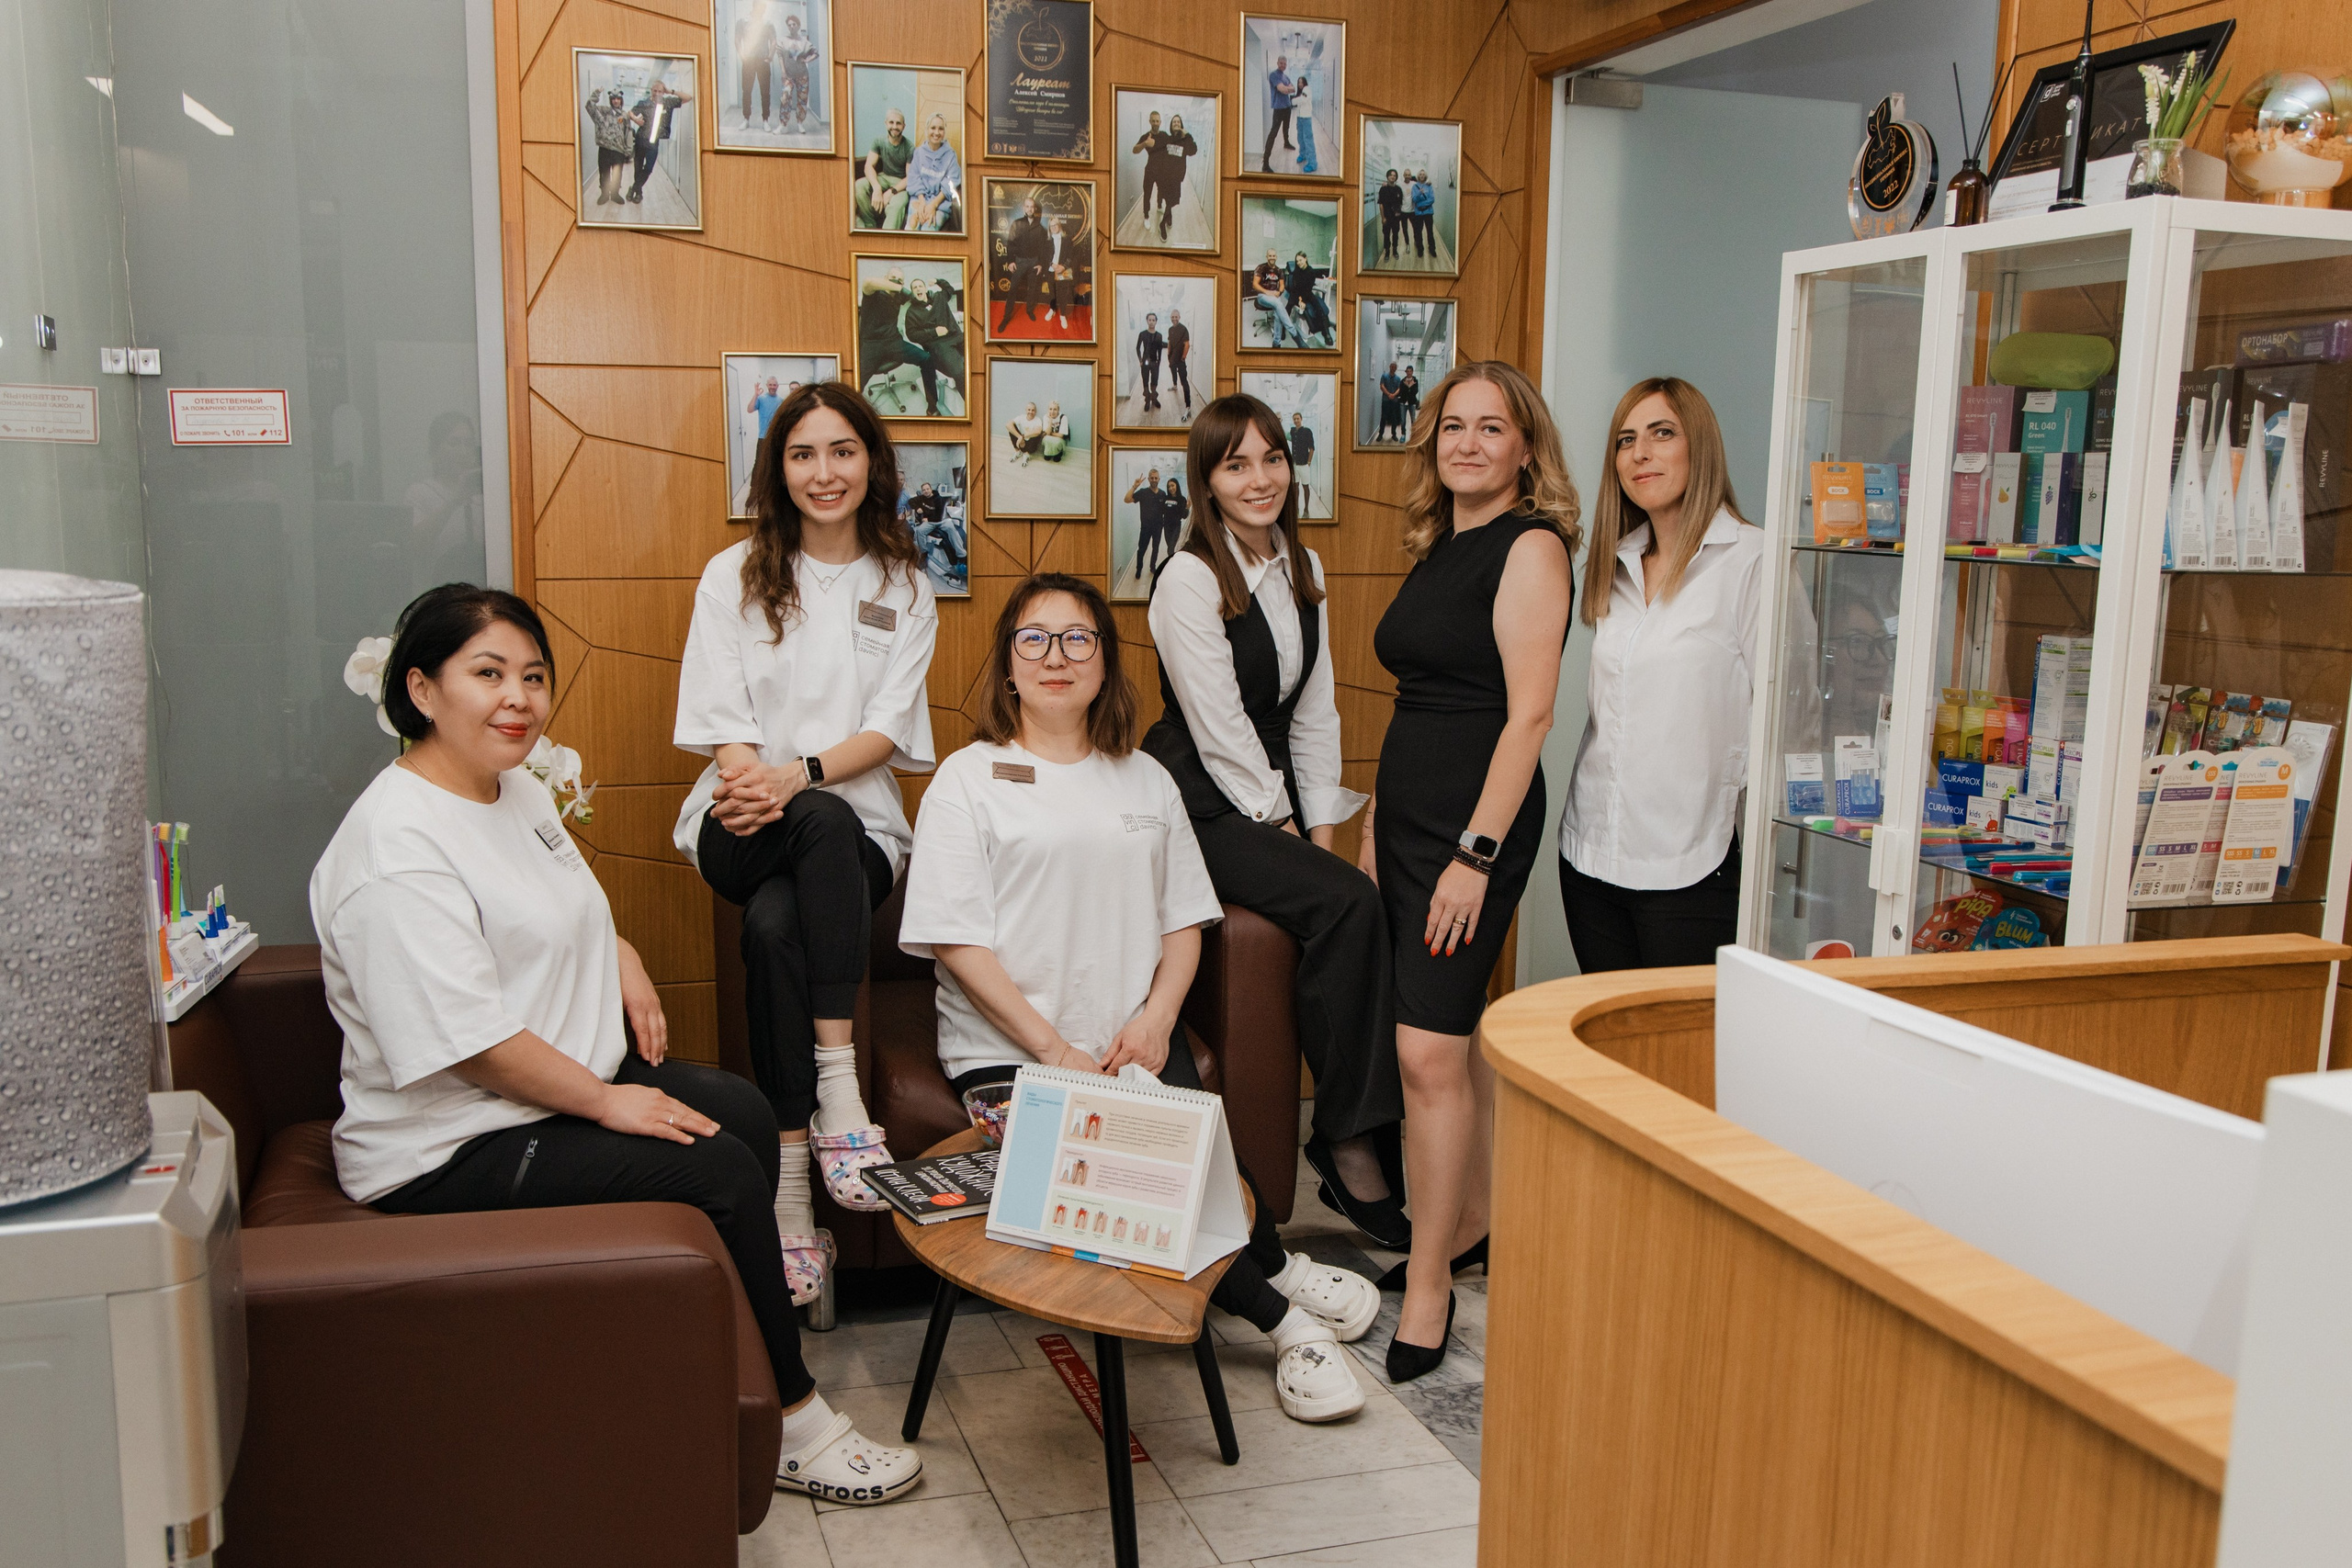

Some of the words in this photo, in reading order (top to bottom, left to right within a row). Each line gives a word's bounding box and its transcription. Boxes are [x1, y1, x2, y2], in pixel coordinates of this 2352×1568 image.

[1011, 72, 1071, 90] Лауреат
[1883, 180, 1899, 198] 2022
[2242, 333, 2288, 347] ОРТОНАБОР
[2179, 384, 2208, 393] EVYLINE
[2041, 423, 2056, 431] 040
[2319, 449, 2329, 489] REVYLINE
[861, 636, 890, 648] семейная
[1995, 743, 2003, 761] YOU
[2280, 766, 2289, 774] M
[1941, 773, 1981, 786] CURAPROX
[1985, 781, 1998, 789] kids
[1928, 802, 1964, 816] CURAPROX
[1969, 810, 1981, 818] kids
[1995, 920, 2033, 944] BLUM
[1057, 1362, 1089, 1396] ДИСТАНЦИЮ
[808, 1480, 884, 1501] crocs
